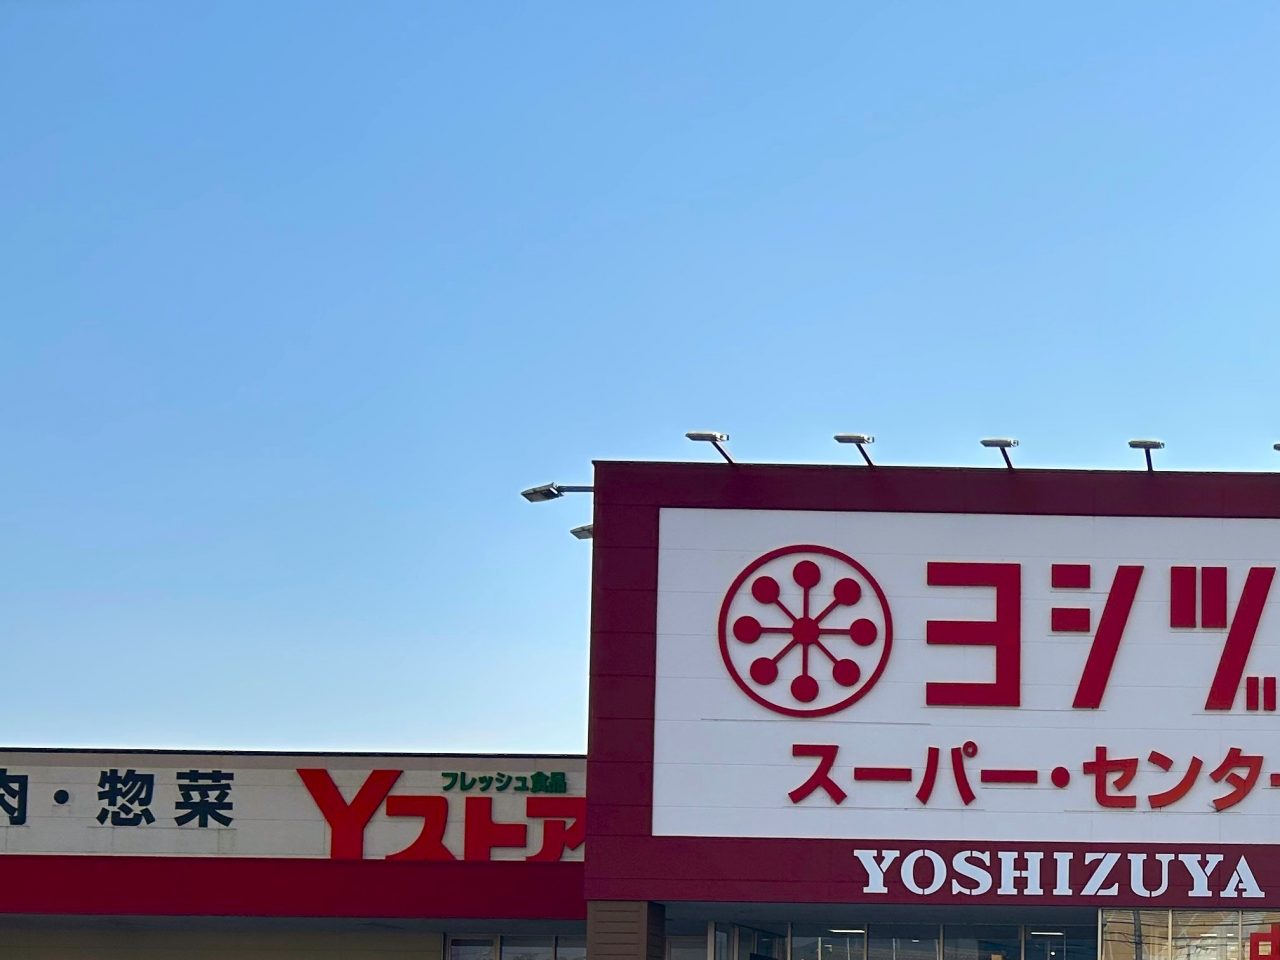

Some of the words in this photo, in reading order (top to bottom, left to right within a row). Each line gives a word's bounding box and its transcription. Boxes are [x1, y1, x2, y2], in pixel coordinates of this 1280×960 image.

[441, 771, 568, 794] フレッシュ食品
[853, 848, 1266, 898] YOSHIZUYA
